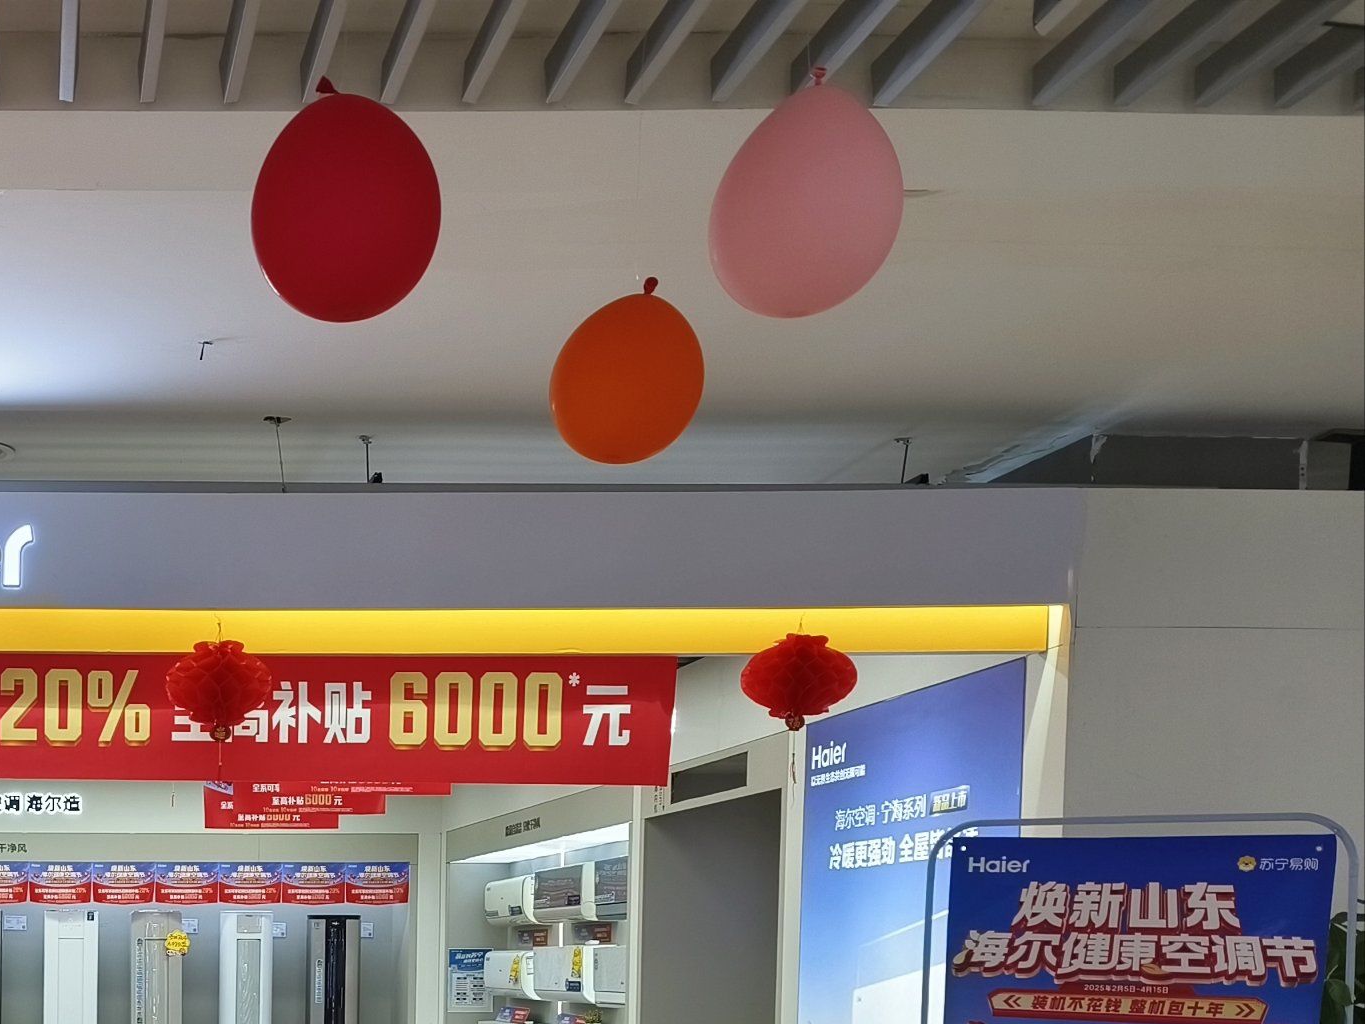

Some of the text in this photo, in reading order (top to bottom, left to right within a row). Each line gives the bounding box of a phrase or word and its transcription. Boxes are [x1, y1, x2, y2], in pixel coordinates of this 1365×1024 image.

[0, 668, 151, 746] 20%
[811, 740, 847, 770] Haier
[26, 794, 81, 812] 海尔造
[834, 793, 928, 831] 海尔空调·宁海系列
[829, 836, 896, 870] 冷暖更强劲
[968, 856, 1030, 873] Haier
[1259, 857, 1319, 872] 苏宁易购
[1012, 881, 1241, 930] 焕新山东
[956, 930, 1318, 978] 海尔健康空调节
[1031, 995, 1226, 1017] 装机不花钱 整机包十年
